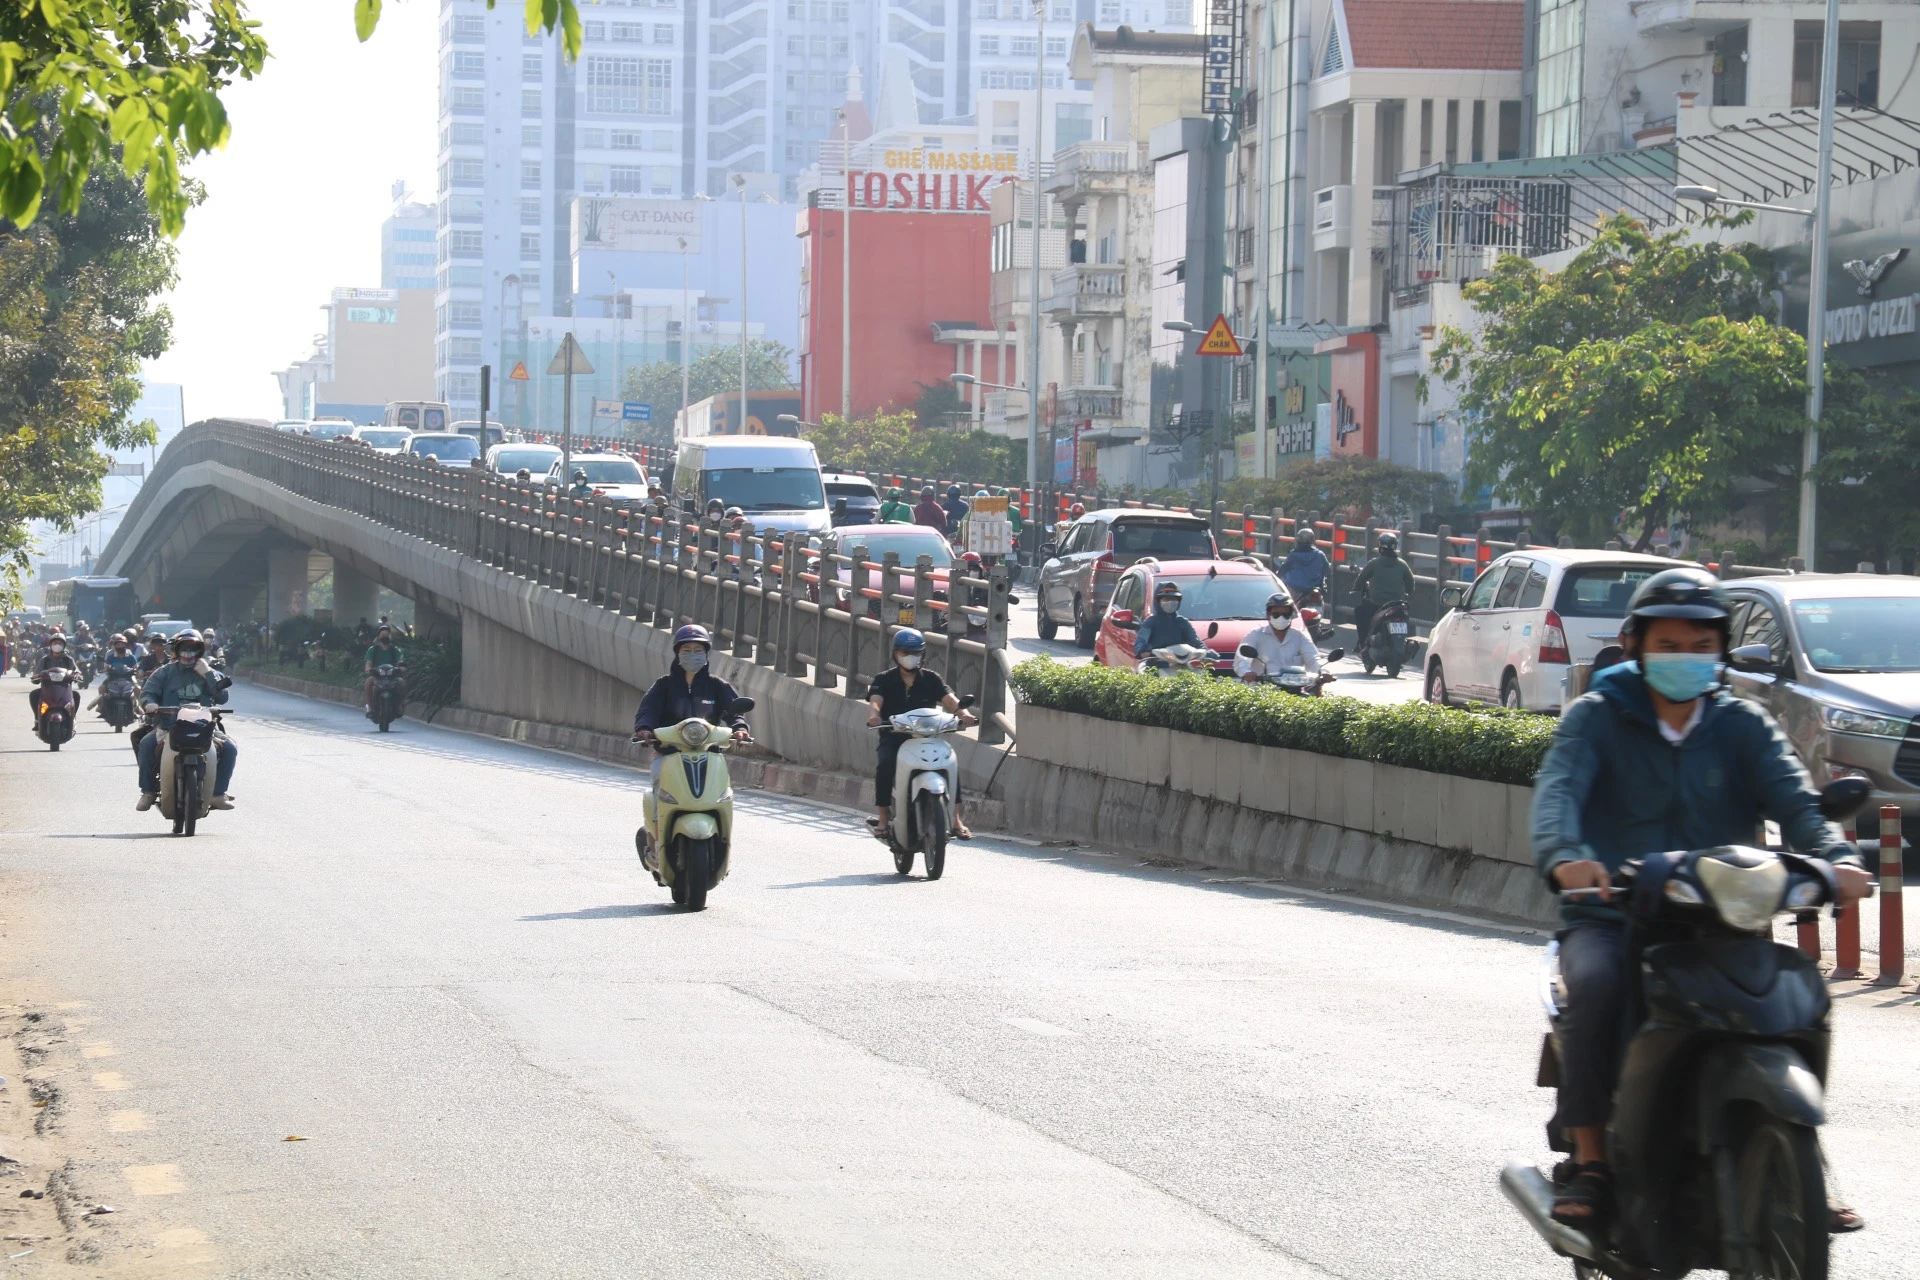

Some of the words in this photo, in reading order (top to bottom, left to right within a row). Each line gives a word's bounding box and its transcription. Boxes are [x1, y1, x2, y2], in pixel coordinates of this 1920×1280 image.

[928, 152, 1018, 172] MASSAGE
[840, 170, 1020, 212] TOSHIK
[1824, 304, 1864, 345] MOTO
[1868, 295, 1915, 337] GUZZI
